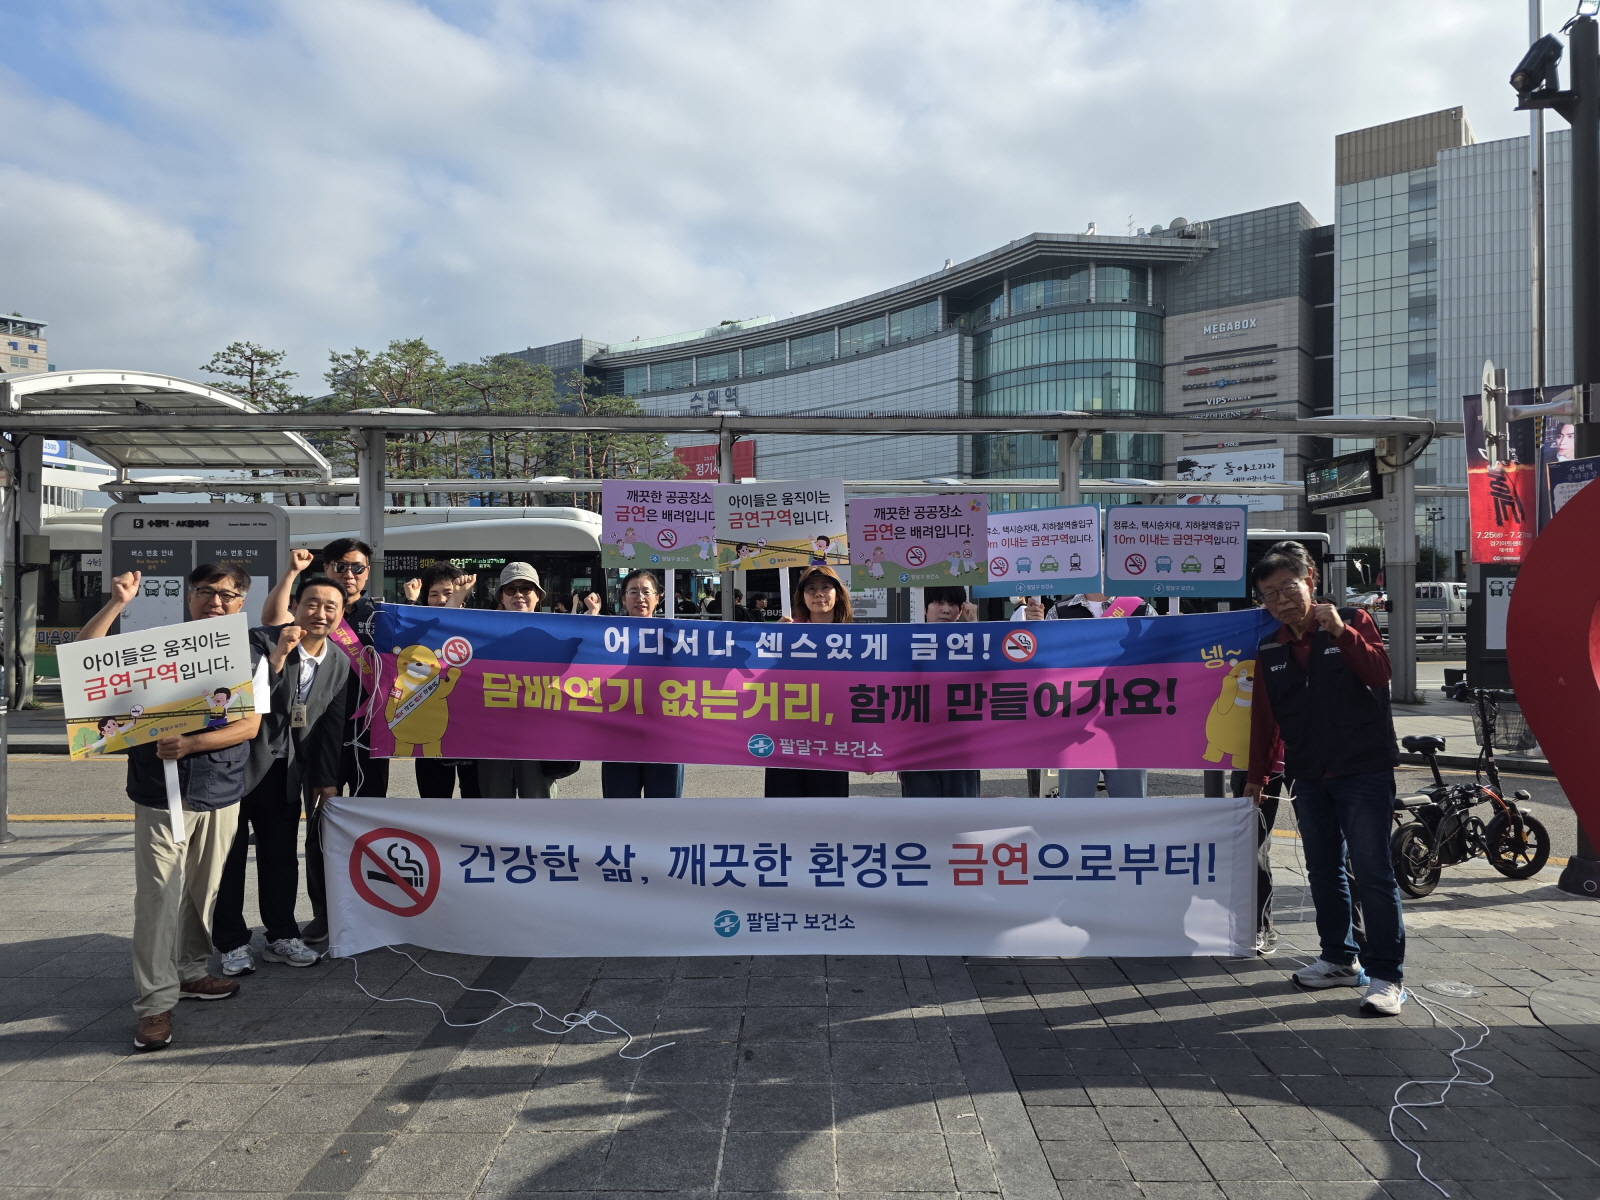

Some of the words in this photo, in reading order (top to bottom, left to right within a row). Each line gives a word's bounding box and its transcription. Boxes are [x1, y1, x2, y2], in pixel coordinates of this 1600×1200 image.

[1203, 318, 1257, 335] MEGABOX
[690, 386, 739, 414] 수원역
[1206, 397, 1227, 406] VIPS
[1223, 461, 1277, 476] 돌아오리라
[627, 490, 662, 504] 깨끗한
[665, 491, 712, 505] 공공장소
[728, 492, 778, 508] 아이들은
[781, 490, 831, 506] 움직이는
[615, 505, 658, 522] 금연은
[728, 509, 833, 529] 금연구역입니다.
[873, 506, 911, 521] 깨끗한
[914, 505, 963, 519] 공공장소
[863, 523, 907, 541] 금연은
[910, 524, 974, 539] 배려입니다.
[1002, 523, 1040, 535] 택시승차대,
[1041, 519, 1094, 531] 지하철역출입구
[1112, 521, 1139, 530] 정류소,
[1141, 521, 1183, 530] 택시승차대,
[1185, 521, 1240, 530] 지하철역출입구
[1001, 537, 1028, 549] 이내는
[1031, 534, 1094, 547] 금연구역입니다.
[1113, 534, 1136, 545] 10m
[1139, 534, 1169, 545] 이내는
[1172, 534, 1240, 546] 금연구역입니다.
[36, 630, 81, 646] 마음외
[603, 626, 735, 657] 어디서나
[755, 631, 888, 661] 센스있게
[910, 632, 991, 661] 금연!
[83, 644, 158, 672] 아이들은
[163, 632, 231, 658] 움직이는
[83, 655, 235, 701] 금연구역입니다.
[482, 672, 644, 715] 담배연기
[658, 679, 834, 726] 없는거리,
[849, 683, 931, 723] 함께
[946, 677, 1178, 722] 만들어가요!
[779, 738, 829, 757] 팔달구
[833, 740, 884, 759] 보건소
[458, 843, 580, 885] 건강한
[594, 843, 649, 886] 삶,
[667, 842, 792, 888] 깨끗한
[808, 842, 932, 888] 환경은
[948, 842, 1217, 886] 금연으로부터!
[745, 912, 799, 932] 팔달구
[803, 912, 856, 931] 보건소
